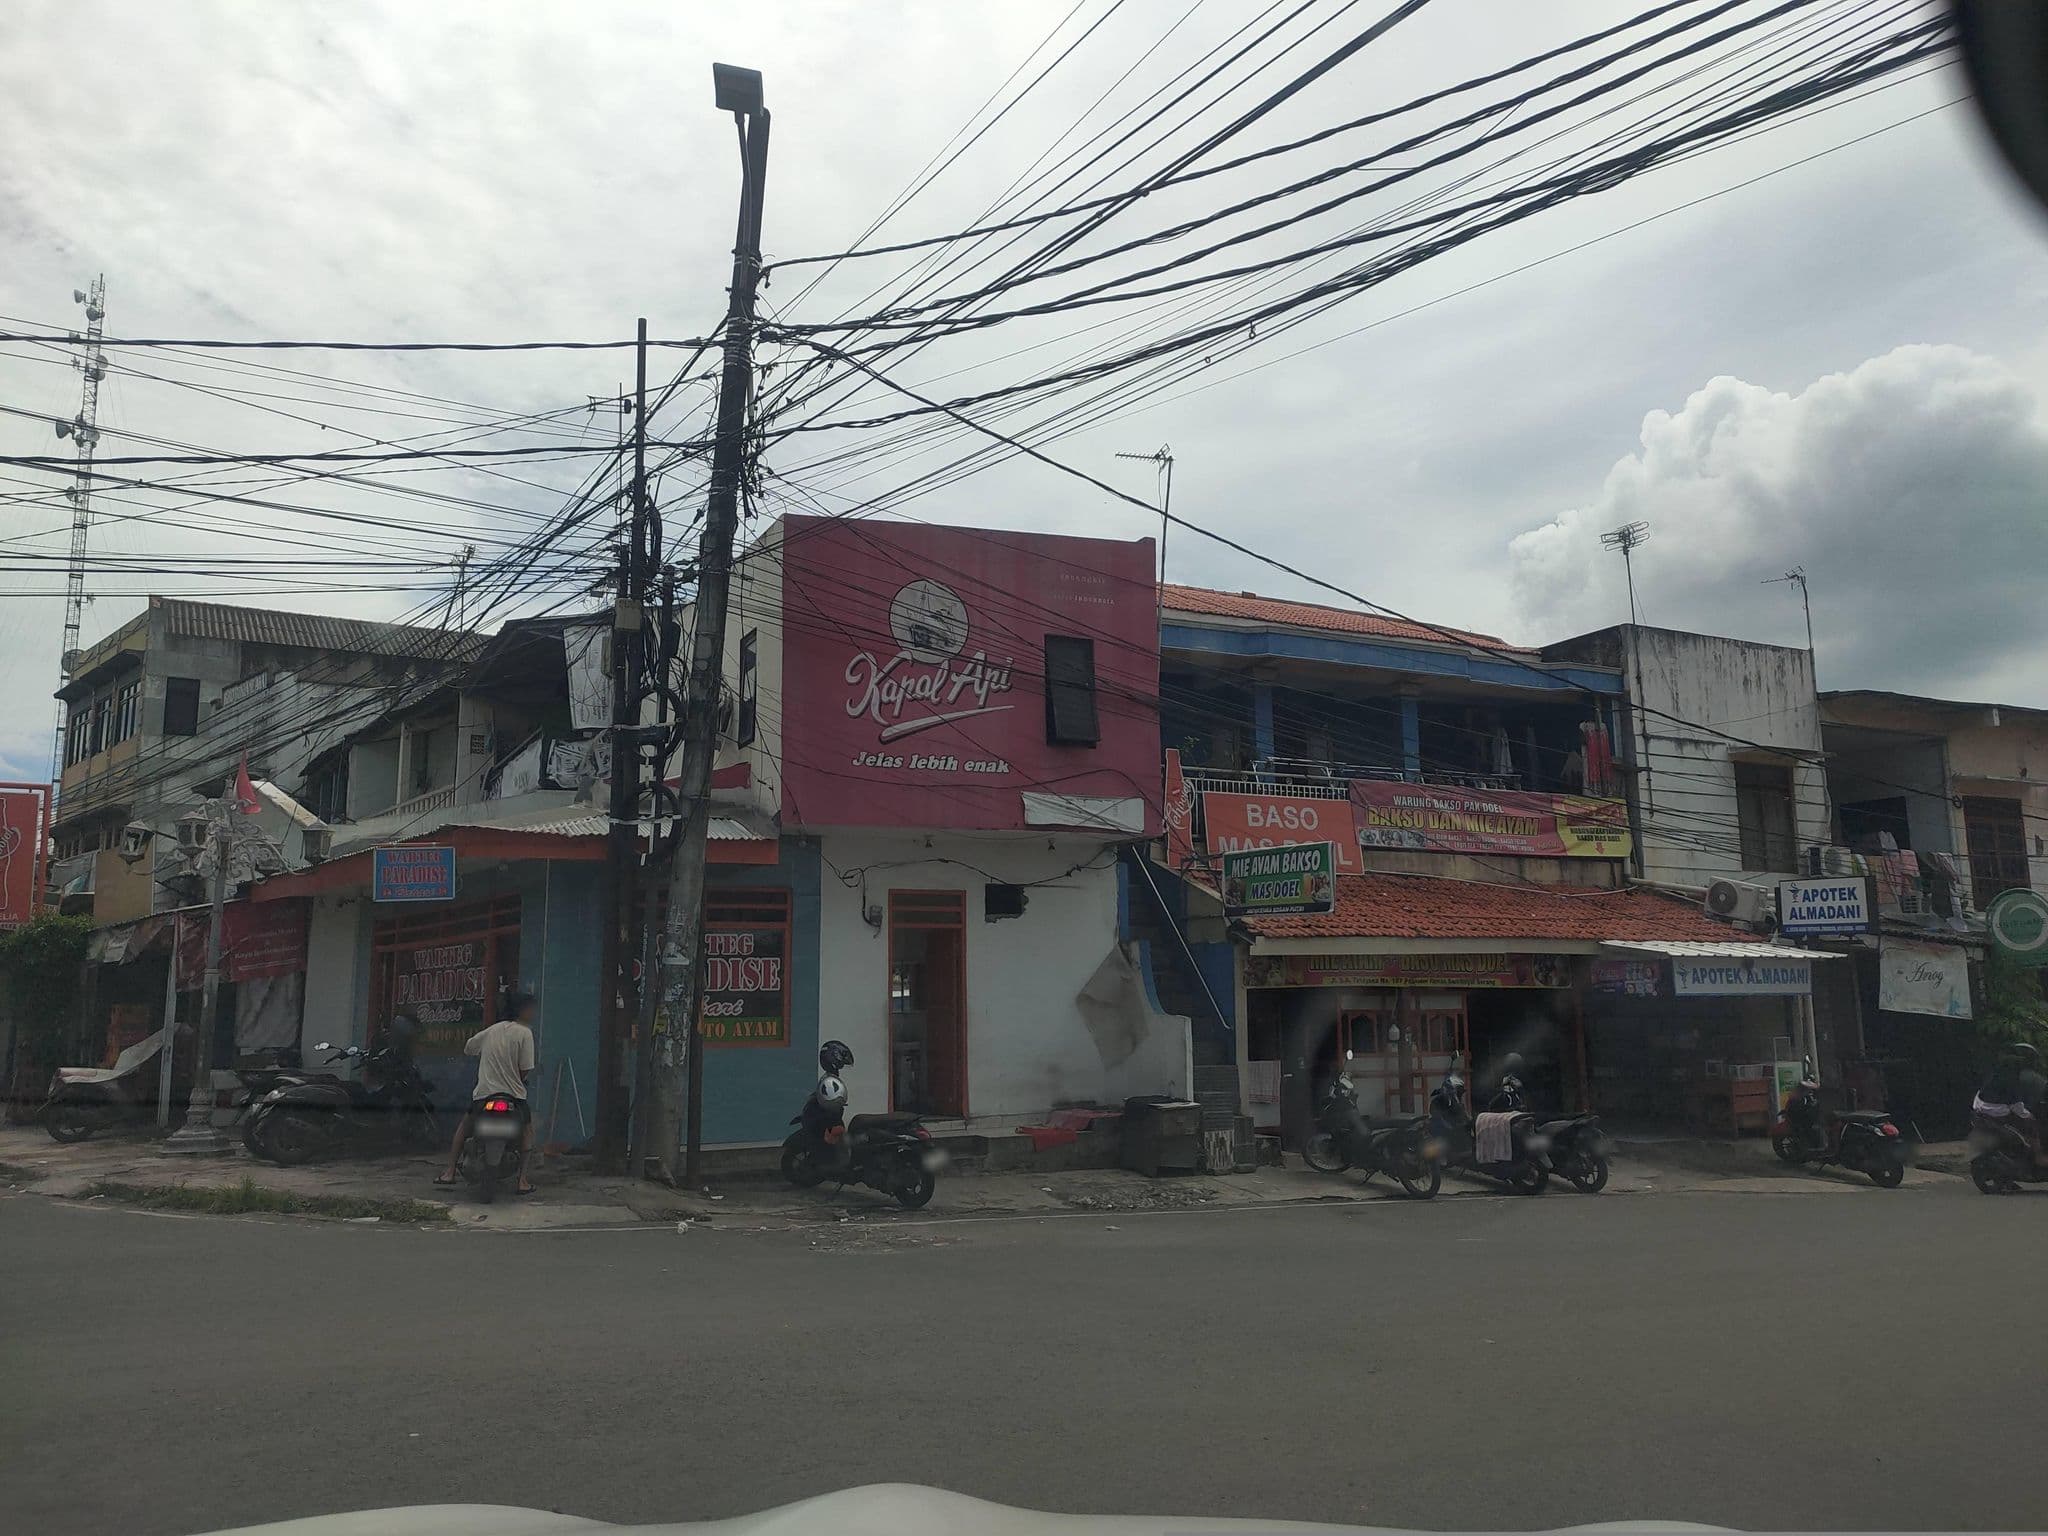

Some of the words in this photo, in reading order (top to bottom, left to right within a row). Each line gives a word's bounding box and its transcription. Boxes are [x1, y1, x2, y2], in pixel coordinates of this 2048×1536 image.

[845, 651, 950, 726] Kapal
[949, 650, 1014, 708] Api
[853, 751, 904, 767] Jelas
[909, 753, 958, 771] lebih
[964, 759, 1010, 773] enak
[1393, 795, 1431, 808] WARUNG
[1433, 799, 1461, 811] BAKSO
[1482, 802, 1504, 814] DOEL
[1246, 803, 1319, 831] BASO
[1367, 806, 1425, 829] BAKSO
[1427, 810, 1462, 832] DAN
[1464, 813, 1495, 834] MIE
[1497, 815, 1541, 837] AYAM
[1231, 859, 1251, 878] MIE
[1251, 855, 1281, 876] AYAM
[1282, 850, 1322, 872] BAKSO
[1251, 880, 1272, 900] MAS
[1274, 878, 1300, 899] DOEL
[1802, 886, 1858, 903] APOTEK
[1789, 904, 1861, 921] ALMADANI
[1692, 967, 1743, 985] APOTEK
[1747, 967, 1809, 985] ALMADANI
[733, 1020, 777, 1038] AYAM
